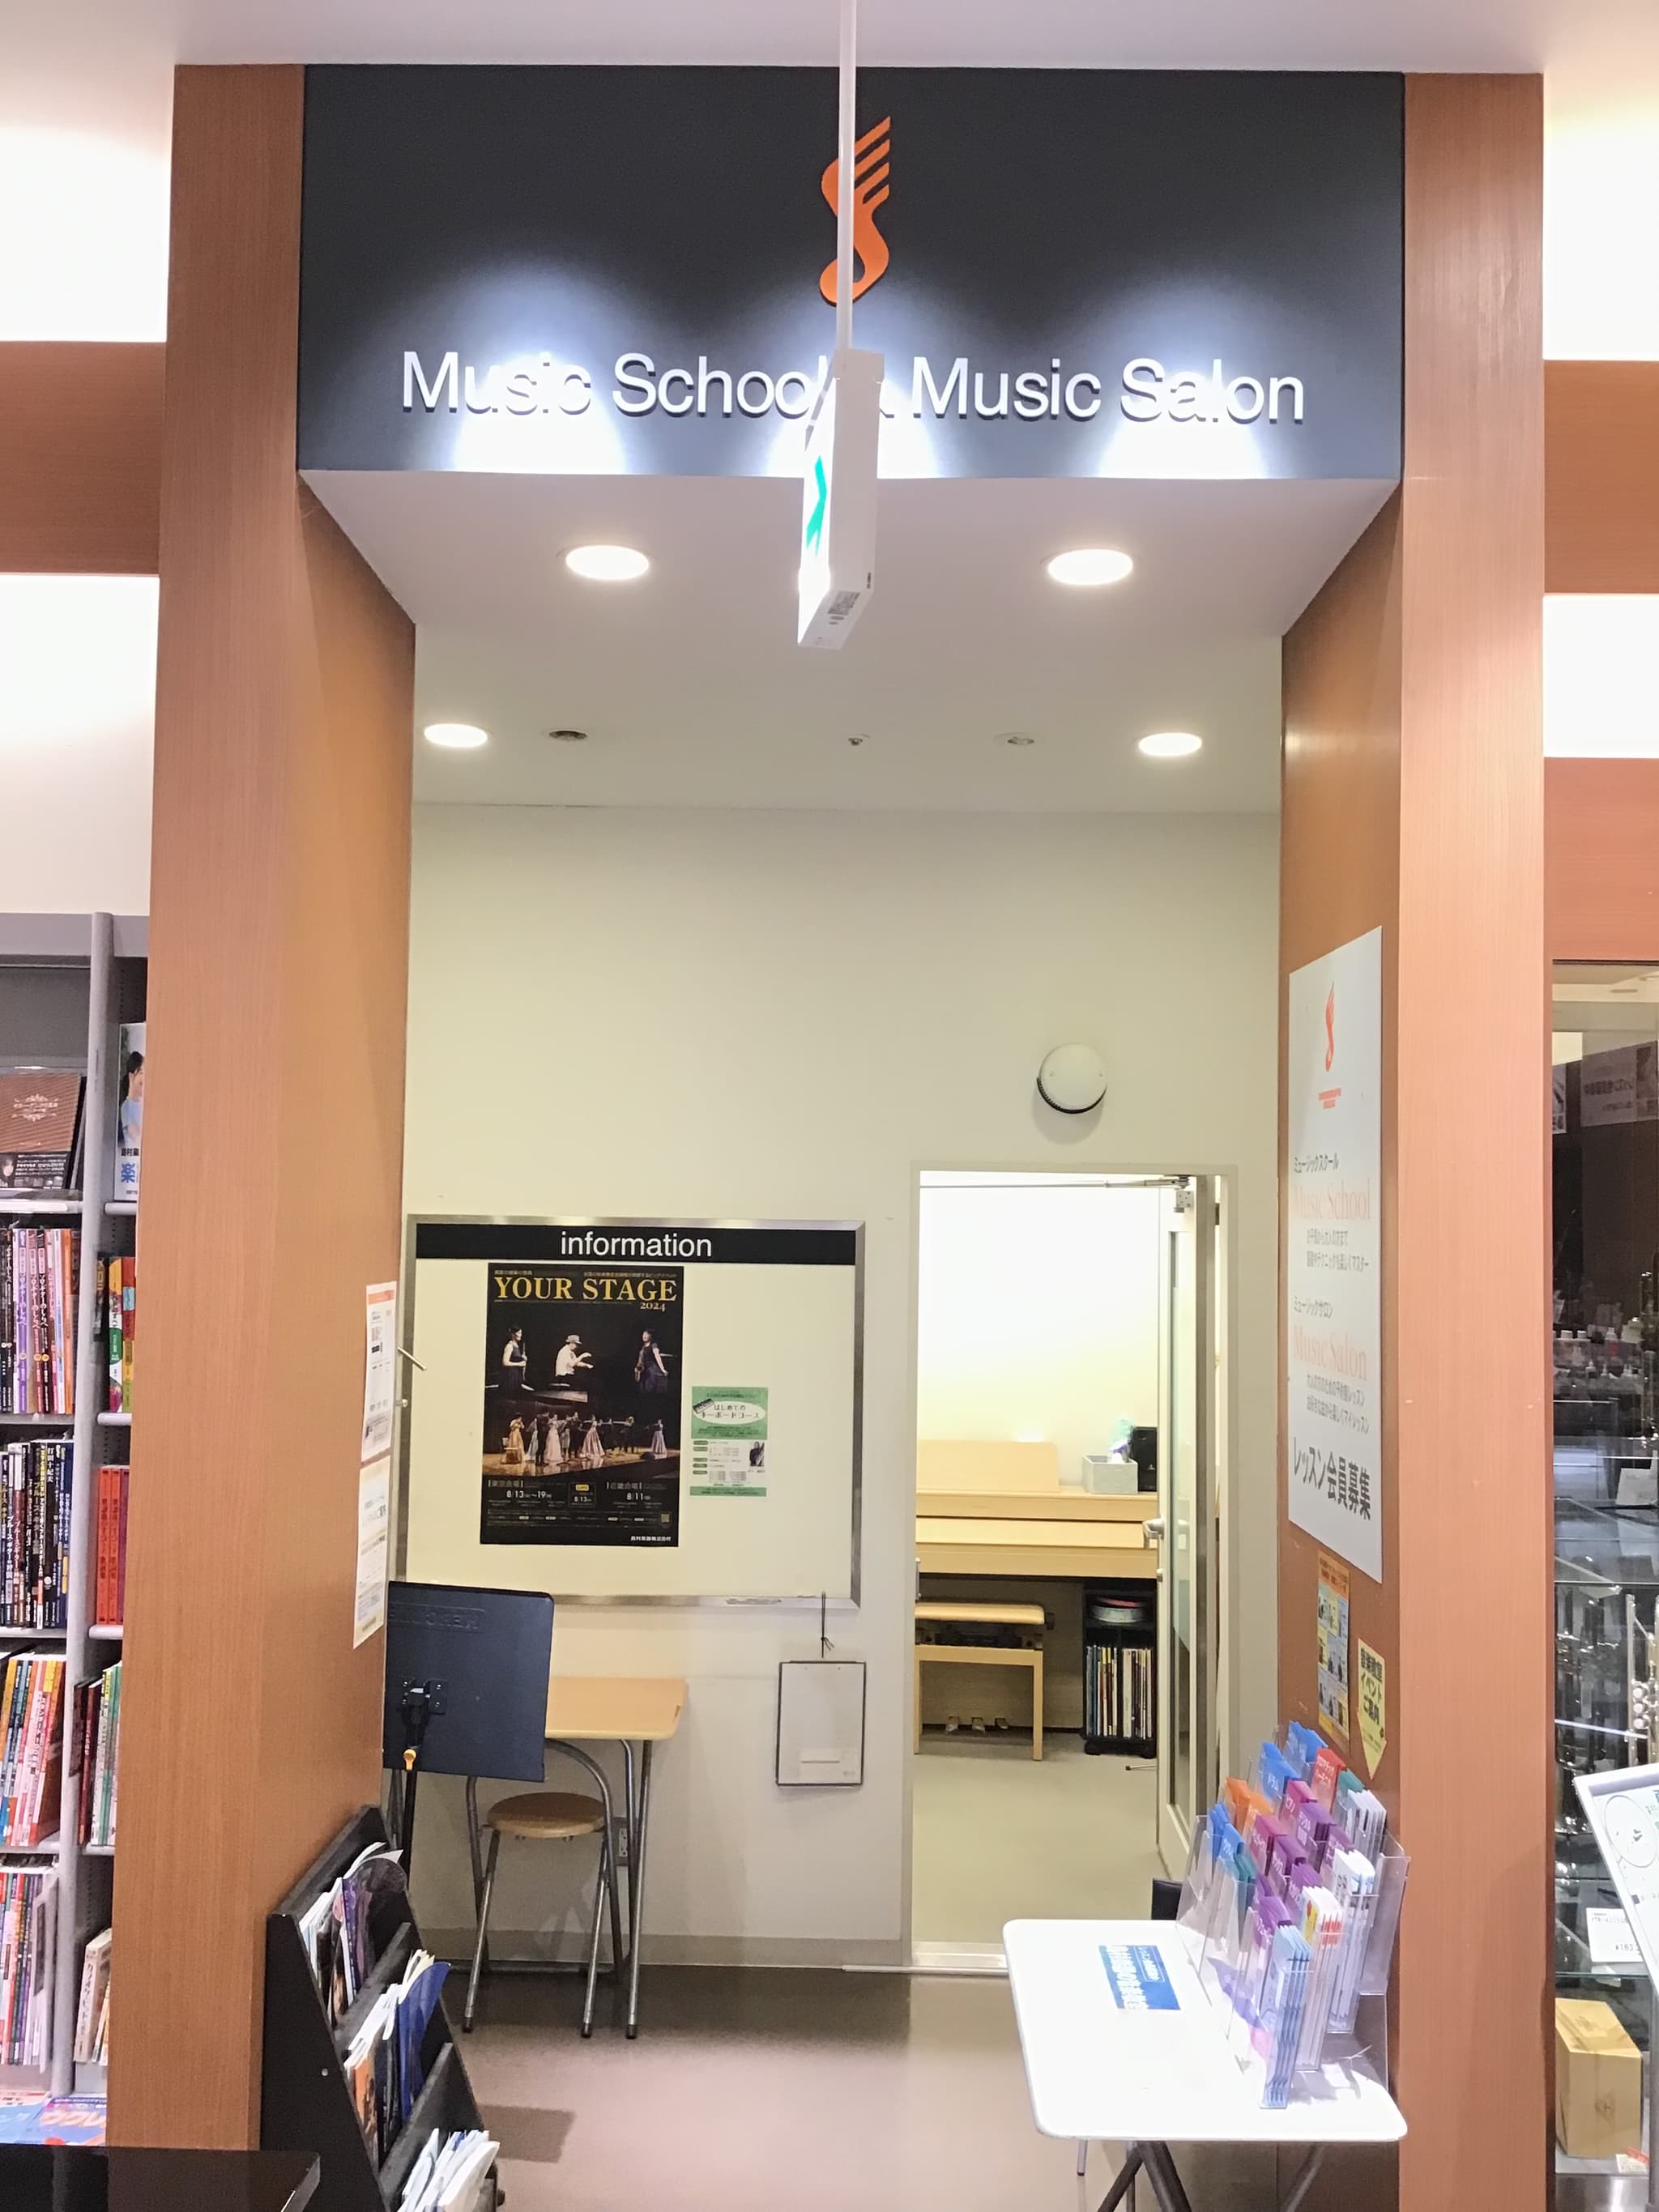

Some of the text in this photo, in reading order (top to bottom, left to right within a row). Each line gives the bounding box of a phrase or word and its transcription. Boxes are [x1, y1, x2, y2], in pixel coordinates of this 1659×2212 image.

[402, 351, 591, 416] Music
[912, 357, 1100, 421] Music
[1120, 359, 1306, 424] Salon
[1327, 1179, 1372, 1221] School
[561, 1232, 712, 1257] information
[494, 1276, 677, 1302] YOUR STAGE
[640, 1302, 667, 1312] 2024
[1328, 1332, 1367, 1382] Salon
[1294, 1436, 1371, 1521] レッスン会員募集
[1361, 1671, 1382, 1704] イベント
